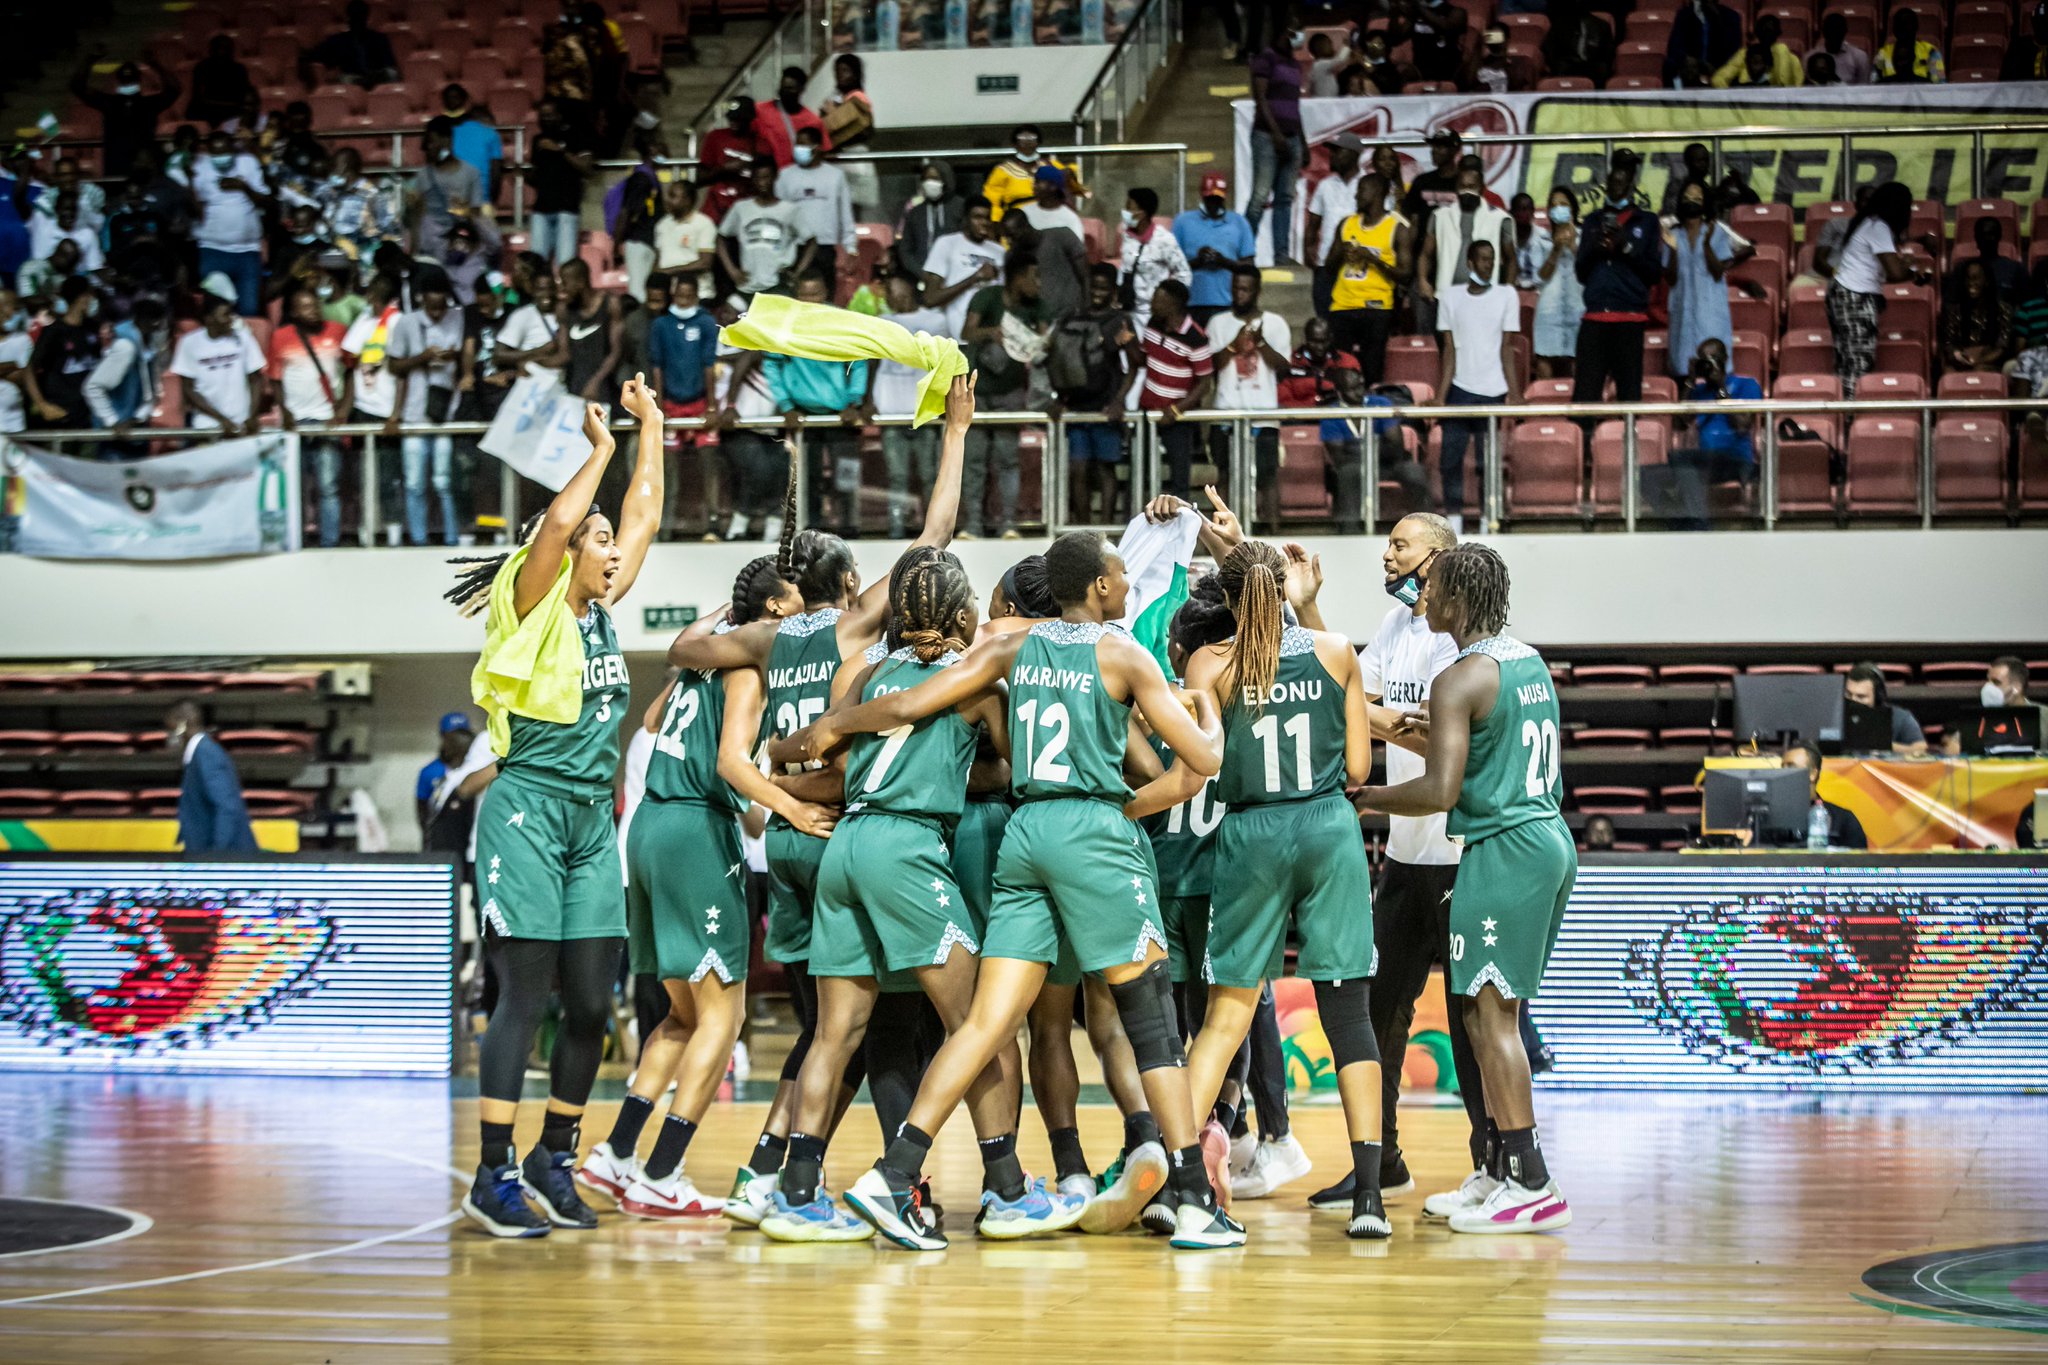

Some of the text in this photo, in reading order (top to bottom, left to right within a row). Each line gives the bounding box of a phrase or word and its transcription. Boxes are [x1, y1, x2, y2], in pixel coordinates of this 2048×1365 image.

[596, 694, 614, 723] 3
[656, 681, 700, 761] 22
[1243, 680, 1322, 706] ELONU
[1516, 682, 1551, 707] MUSA
[862, 723, 915, 794] 7
[1016, 698, 1071, 783] 12
[1251, 712, 1313, 793] 11
[1522, 718, 1559, 798] 20
